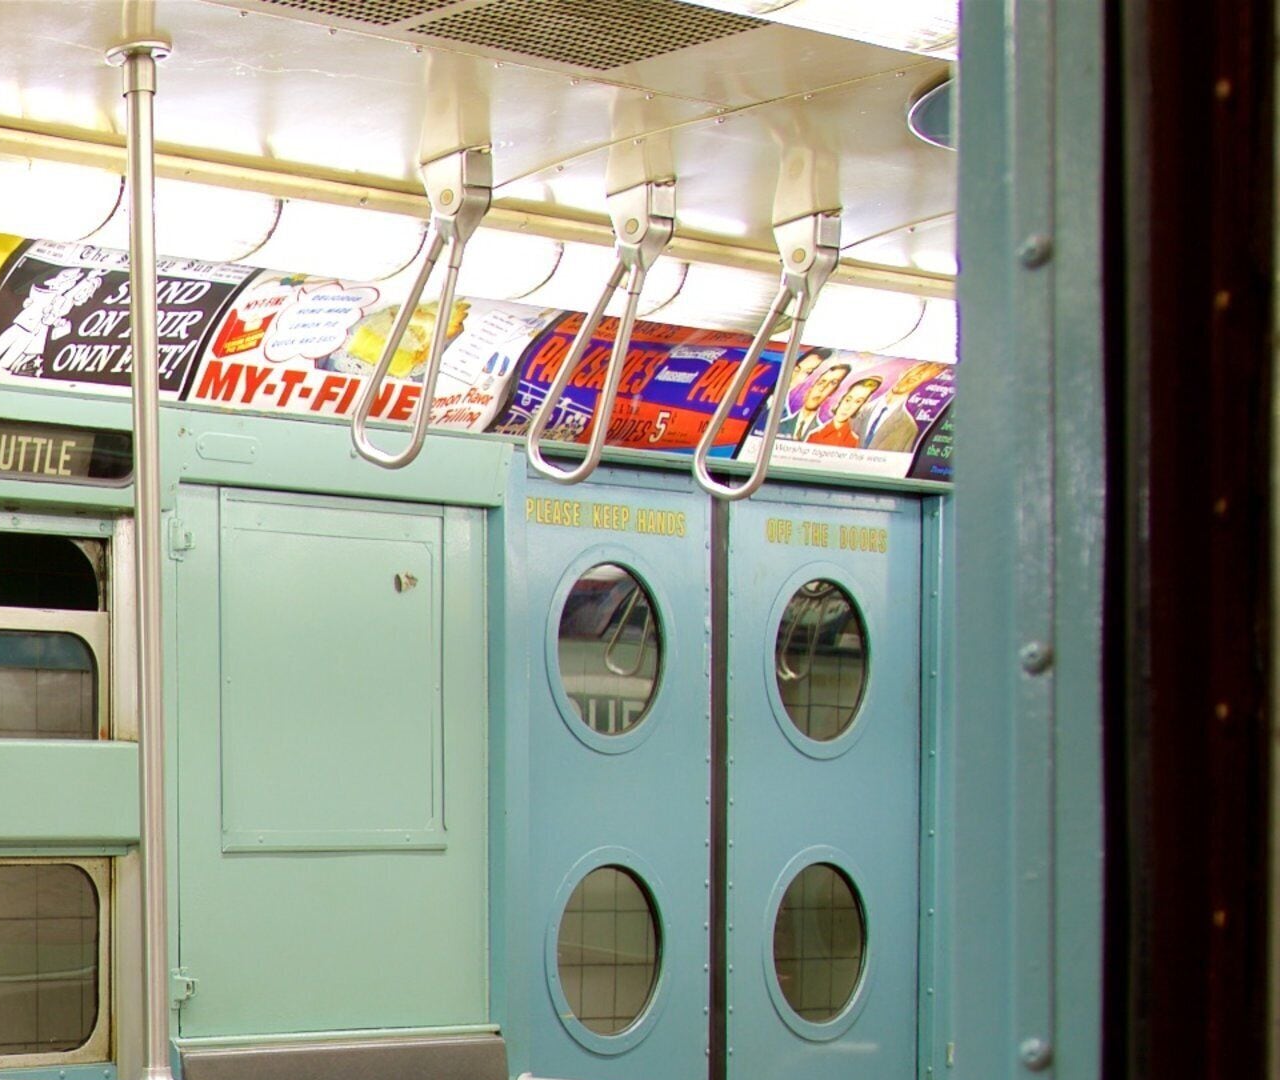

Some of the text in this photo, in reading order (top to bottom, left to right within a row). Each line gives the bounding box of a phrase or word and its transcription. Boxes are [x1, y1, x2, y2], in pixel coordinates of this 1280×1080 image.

[79, 245, 109, 263] The
[52, 343, 121, 372] OWN
[526, 497, 686, 538] PLEASE KEEP HANDS
[766, 517, 888, 555] OFF THE DOORS
